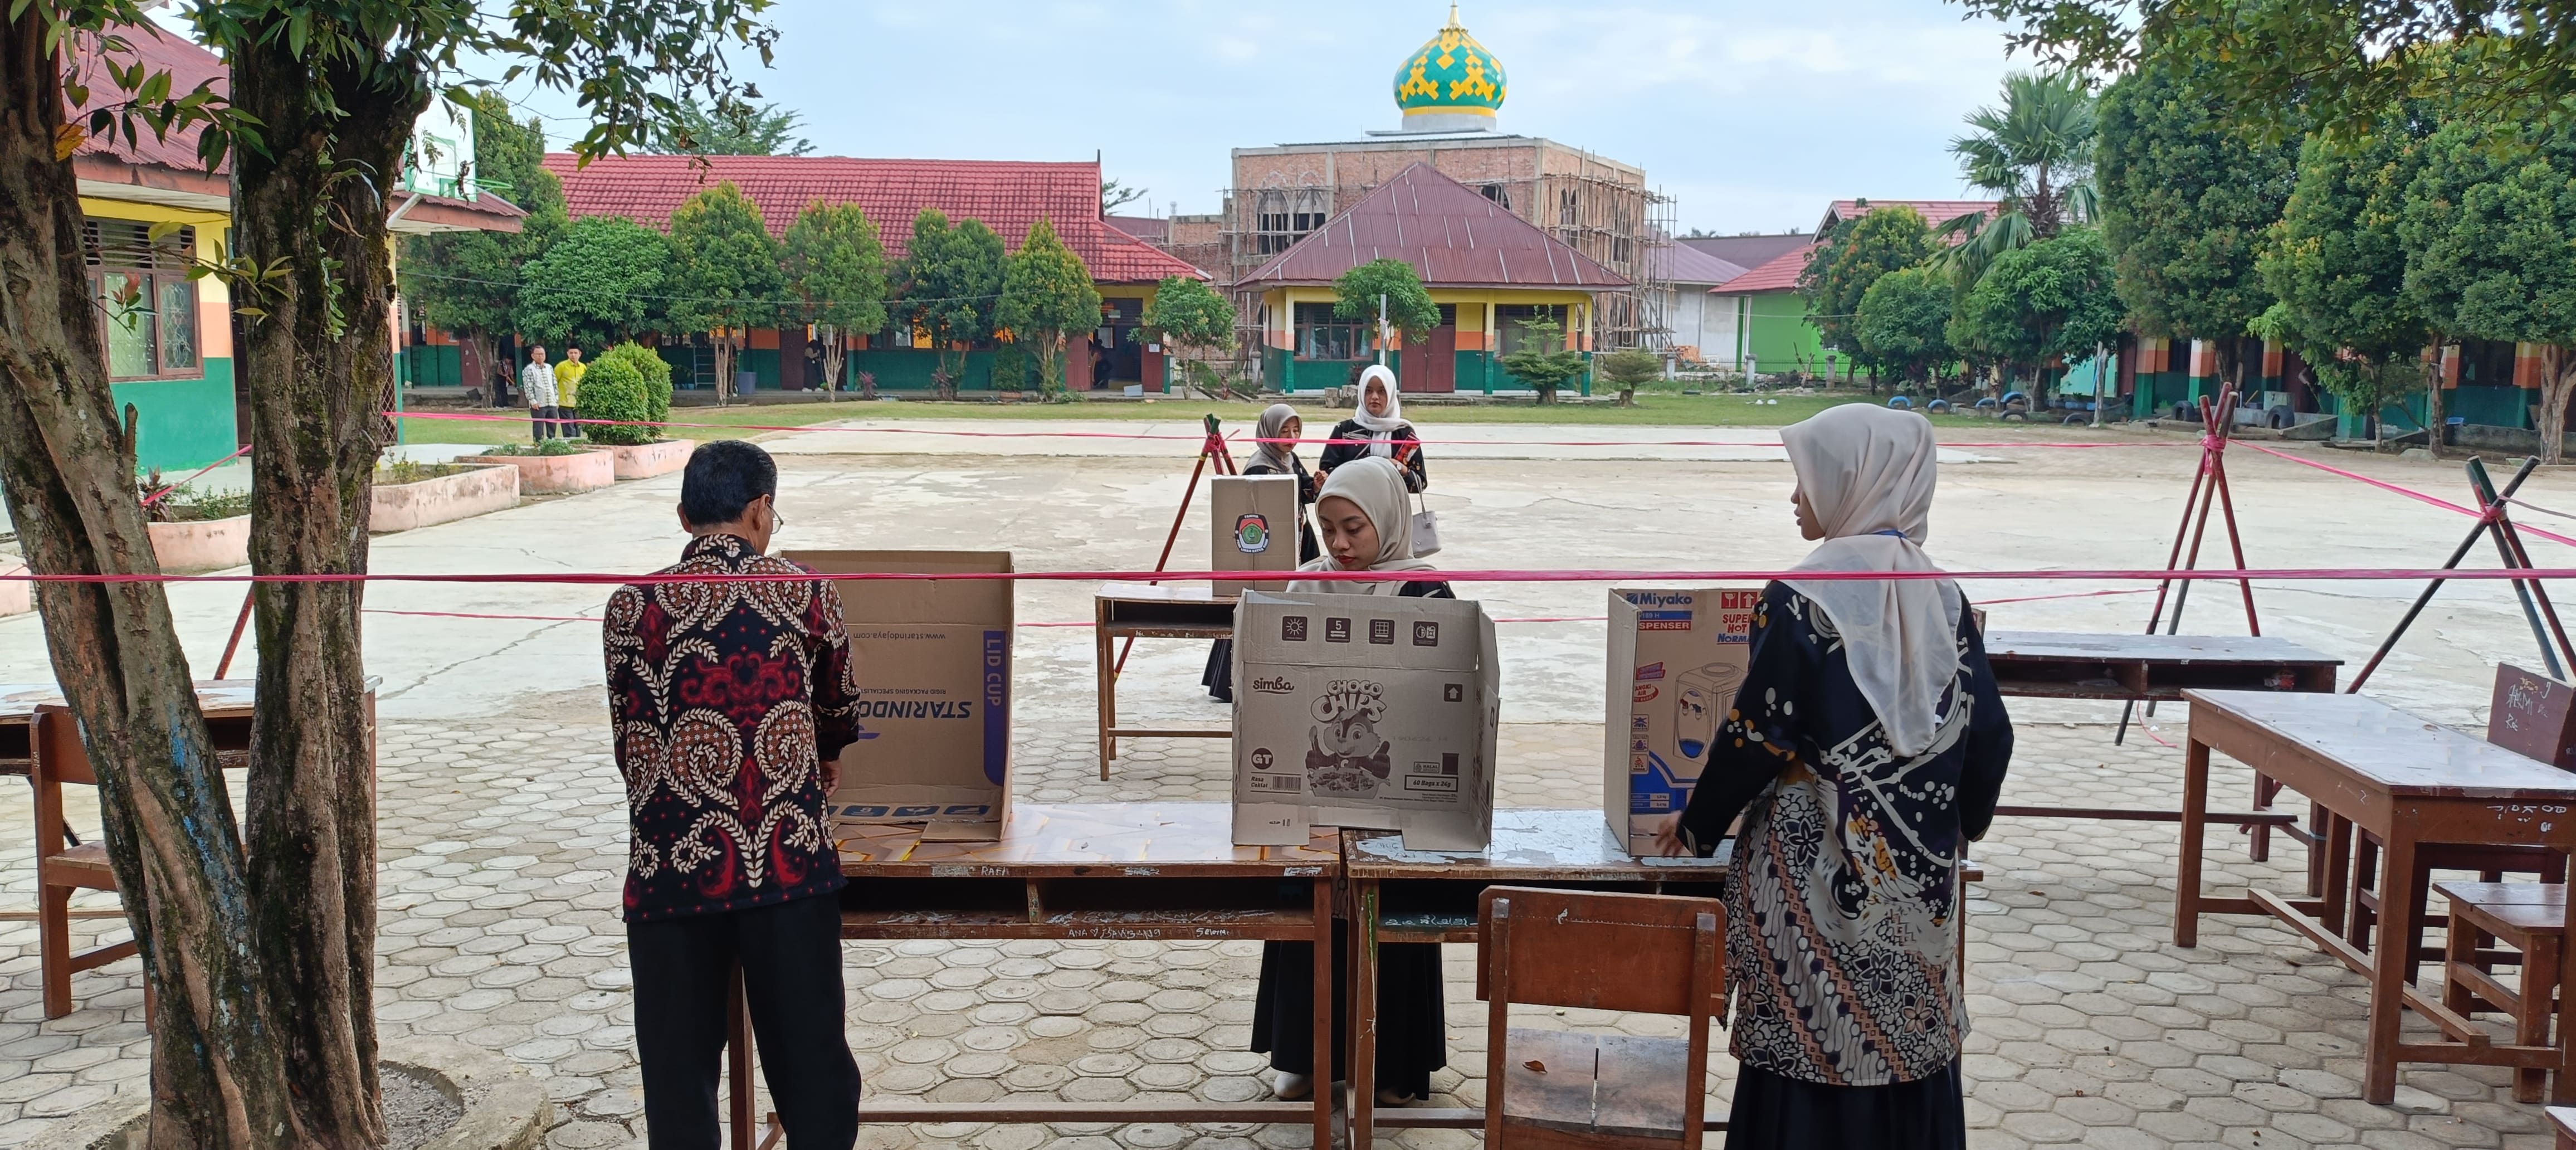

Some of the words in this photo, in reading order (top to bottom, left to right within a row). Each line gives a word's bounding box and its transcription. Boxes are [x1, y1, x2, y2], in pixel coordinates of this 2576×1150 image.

[1640, 593, 1692, 608] Miyako
[1335, 620, 1342, 630] 5
[1728, 624, 1747, 633] HOT
[987, 639, 1001, 666] LID
[987, 673, 1002, 706] CUP
[1253, 676, 1295, 691] simba
[1326, 679, 1384, 696] CHOCO
[1310, 694, 1387, 723] CHIPS
[1252, 753, 1272, 764] GT
[1067, 929, 1087, 937] ANA
